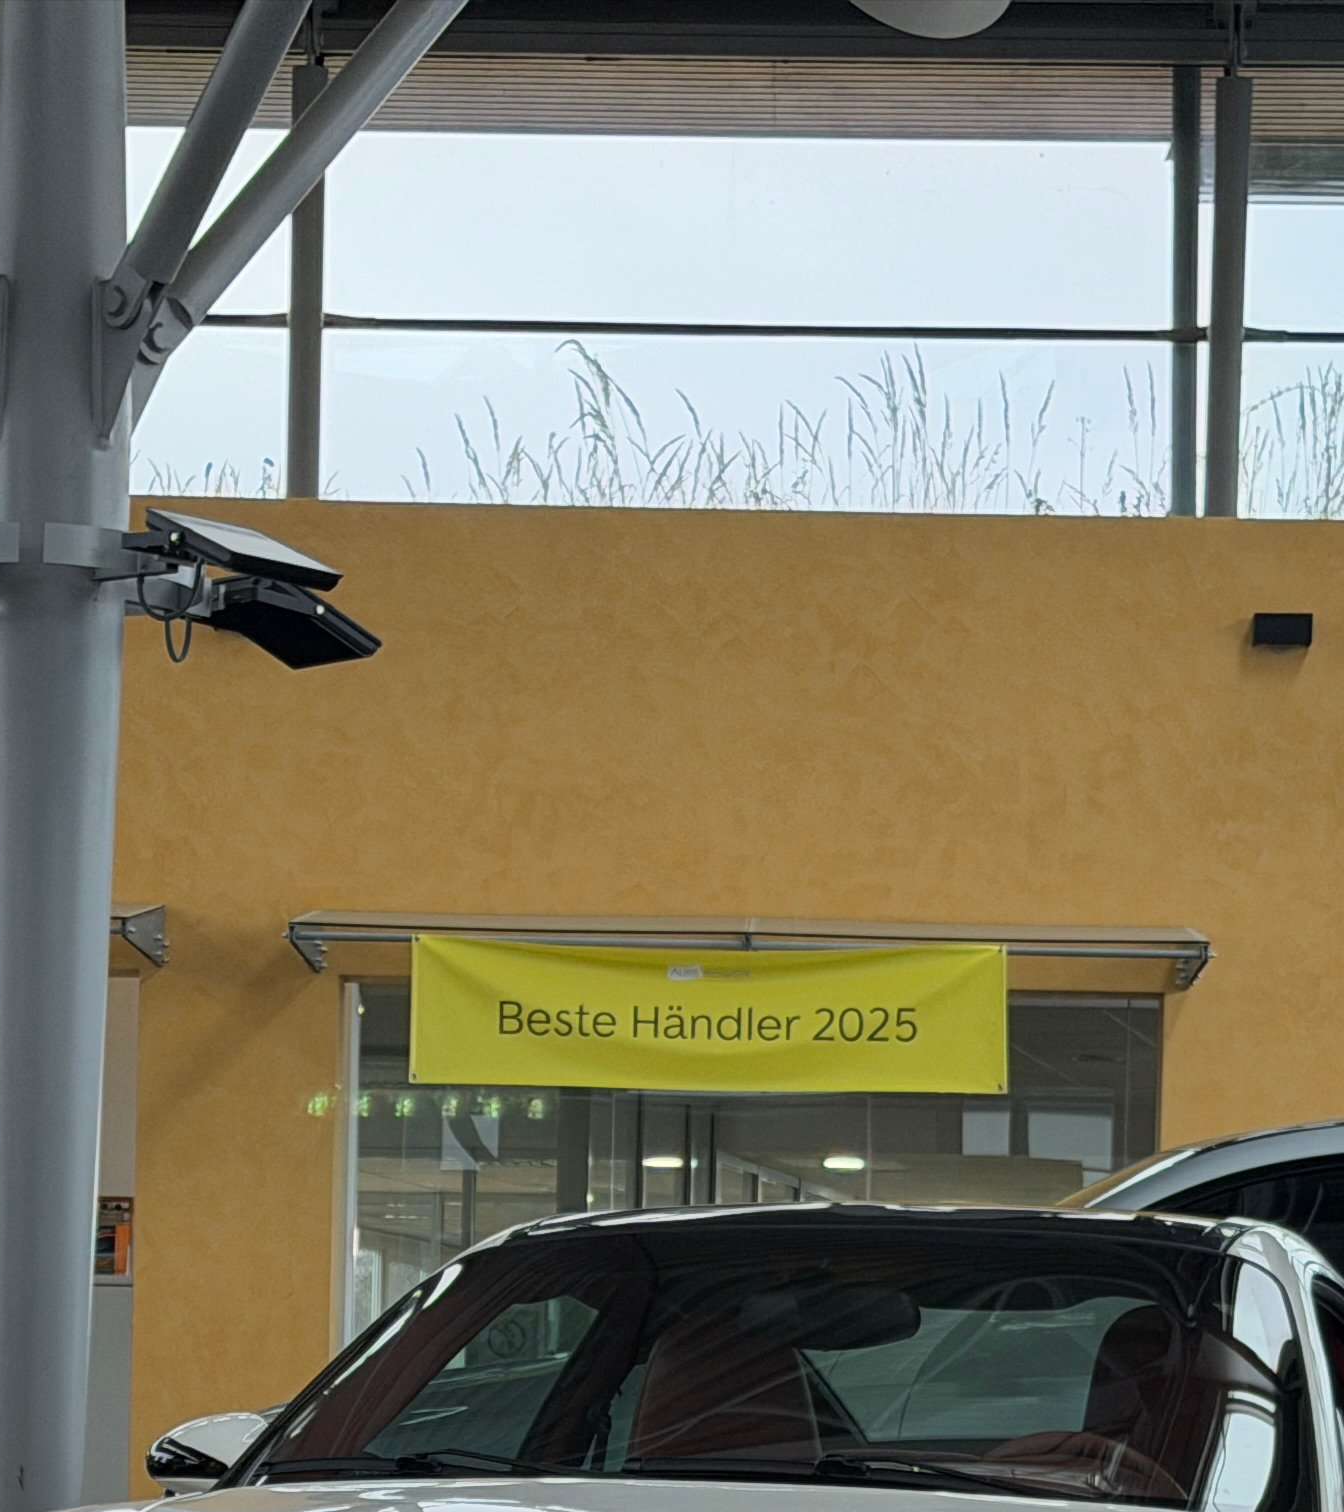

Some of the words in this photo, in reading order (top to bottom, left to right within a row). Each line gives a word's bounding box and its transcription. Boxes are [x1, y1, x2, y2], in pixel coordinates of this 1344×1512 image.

[498, 1000, 616, 1038] Beste
[632, 1005, 801, 1042] Händler
[812, 1007, 919, 1044] 2025
